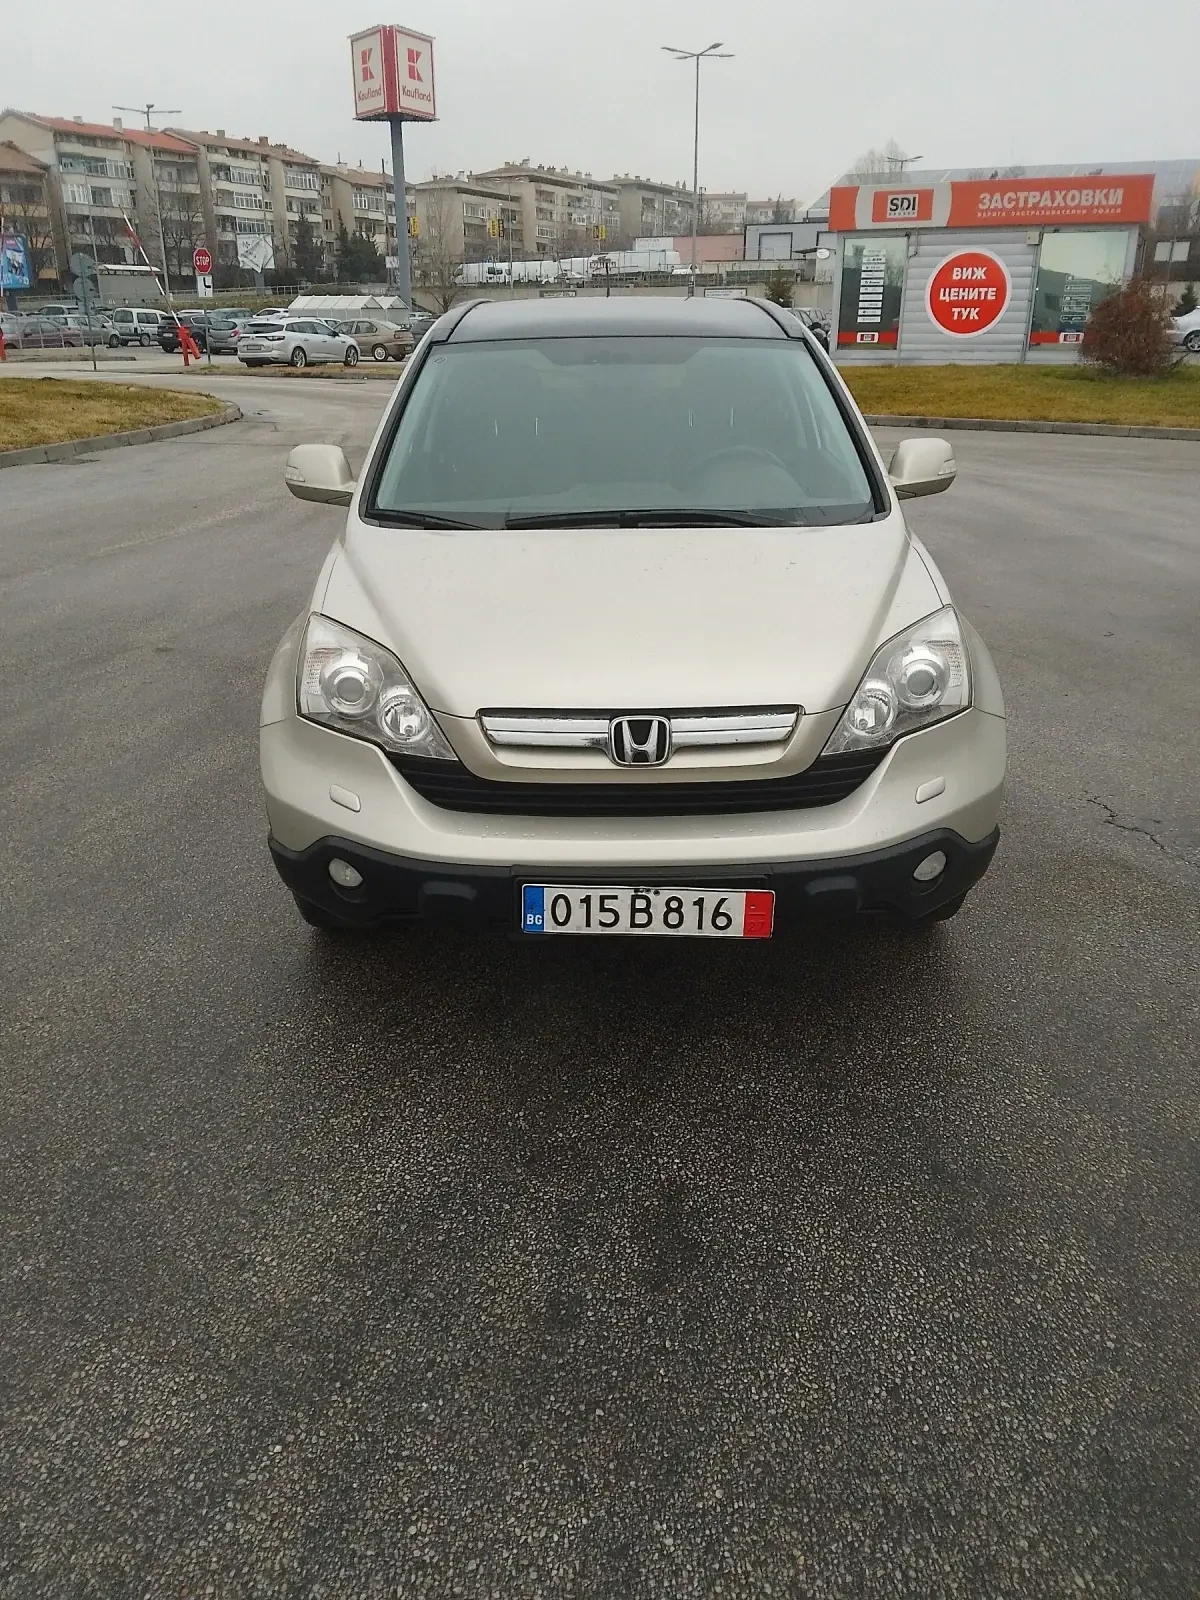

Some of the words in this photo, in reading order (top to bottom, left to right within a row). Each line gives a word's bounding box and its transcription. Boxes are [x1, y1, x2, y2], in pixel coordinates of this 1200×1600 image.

[358, 84, 382, 102] Kaufland
[402, 84, 431, 102] Kaufland
[889, 197, 917, 212] SDI
[978, 188, 1124, 209] ЗАСТРАХОВКИ
[195, 255, 210, 266] STOP
[952, 267, 988, 280] ВИЖ
[939, 287, 997, 302] ЦЕНИТЕ
[951, 307, 980, 321] ТУК
[526, 913, 543, 925] BG
